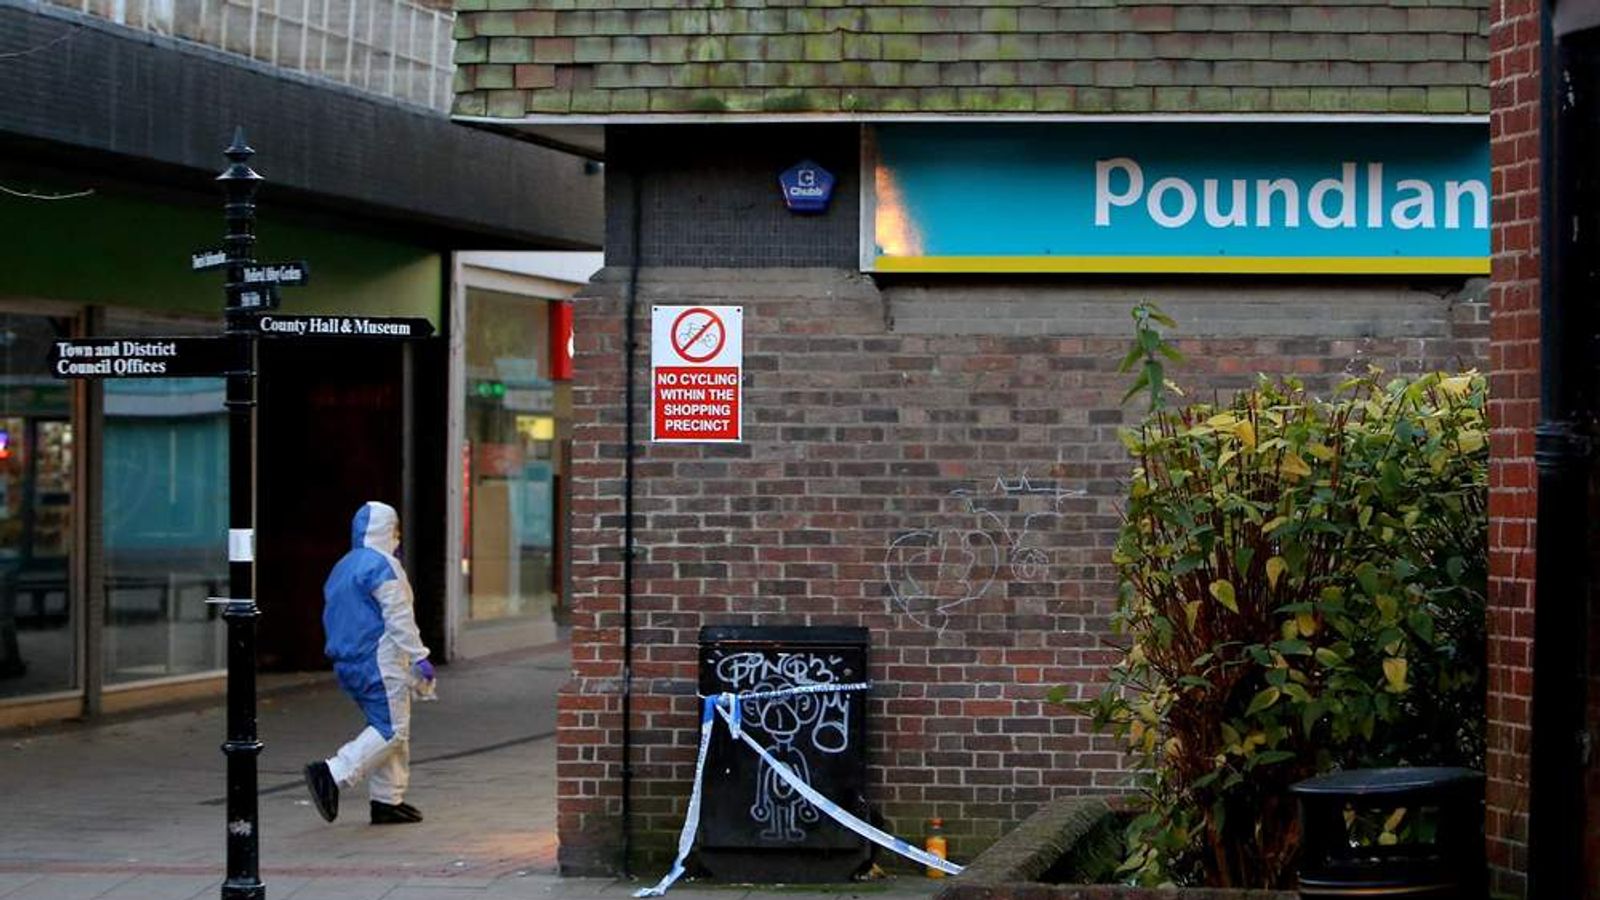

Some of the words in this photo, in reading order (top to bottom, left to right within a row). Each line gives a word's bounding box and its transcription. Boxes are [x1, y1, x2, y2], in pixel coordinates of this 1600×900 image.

[790, 186, 823, 197] Chubb
[1094, 157, 1489, 229] Poundlan
[260, 316, 307, 335] County
[309, 318, 339, 333] Hall
[340, 318, 352, 333] &
[353, 319, 411, 335] Museum
[56, 342, 93, 357] Town
[95, 341, 119, 356] and
[122, 341, 177, 356] District
[57, 359, 111, 374] Council
[113, 359, 166, 376] Offices
[657, 373, 677, 385] NO
[680, 373, 737, 385] CYCLING
[660, 389, 705, 400] WITHIN
[708, 389, 735, 400] THE
[664, 404, 731, 416] SHOPPING
[665, 420, 730, 431] PRECINCT
